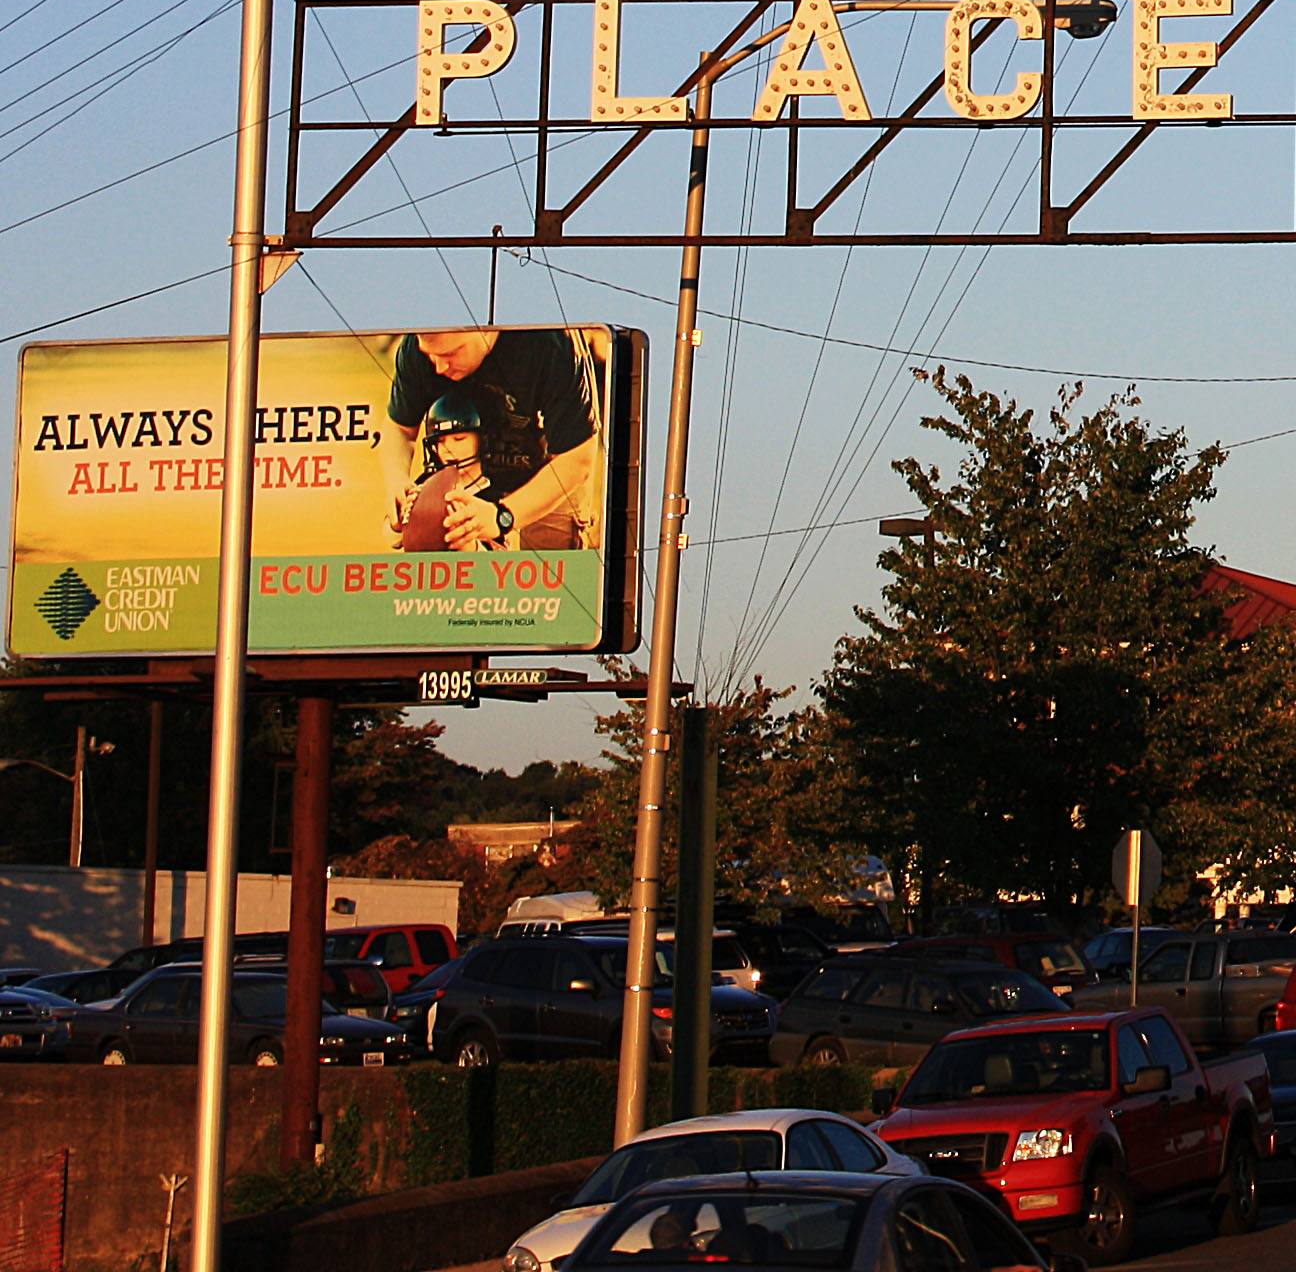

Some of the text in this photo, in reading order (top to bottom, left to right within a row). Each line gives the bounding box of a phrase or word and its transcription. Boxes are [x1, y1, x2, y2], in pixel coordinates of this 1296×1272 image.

[34, 408, 214, 451] ALWAYS
[68, 455, 342, 495] ALL THE IME.
[106, 565, 200, 588] EASTMAN
[260, 560, 565, 595] ECU BESIDE YOU
[105, 587, 178, 610] CREDIT
[393, 596, 561, 621] www.ecu.org
[105, 610, 171, 633] UNION
[480, 671, 541, 684] LAMAR
